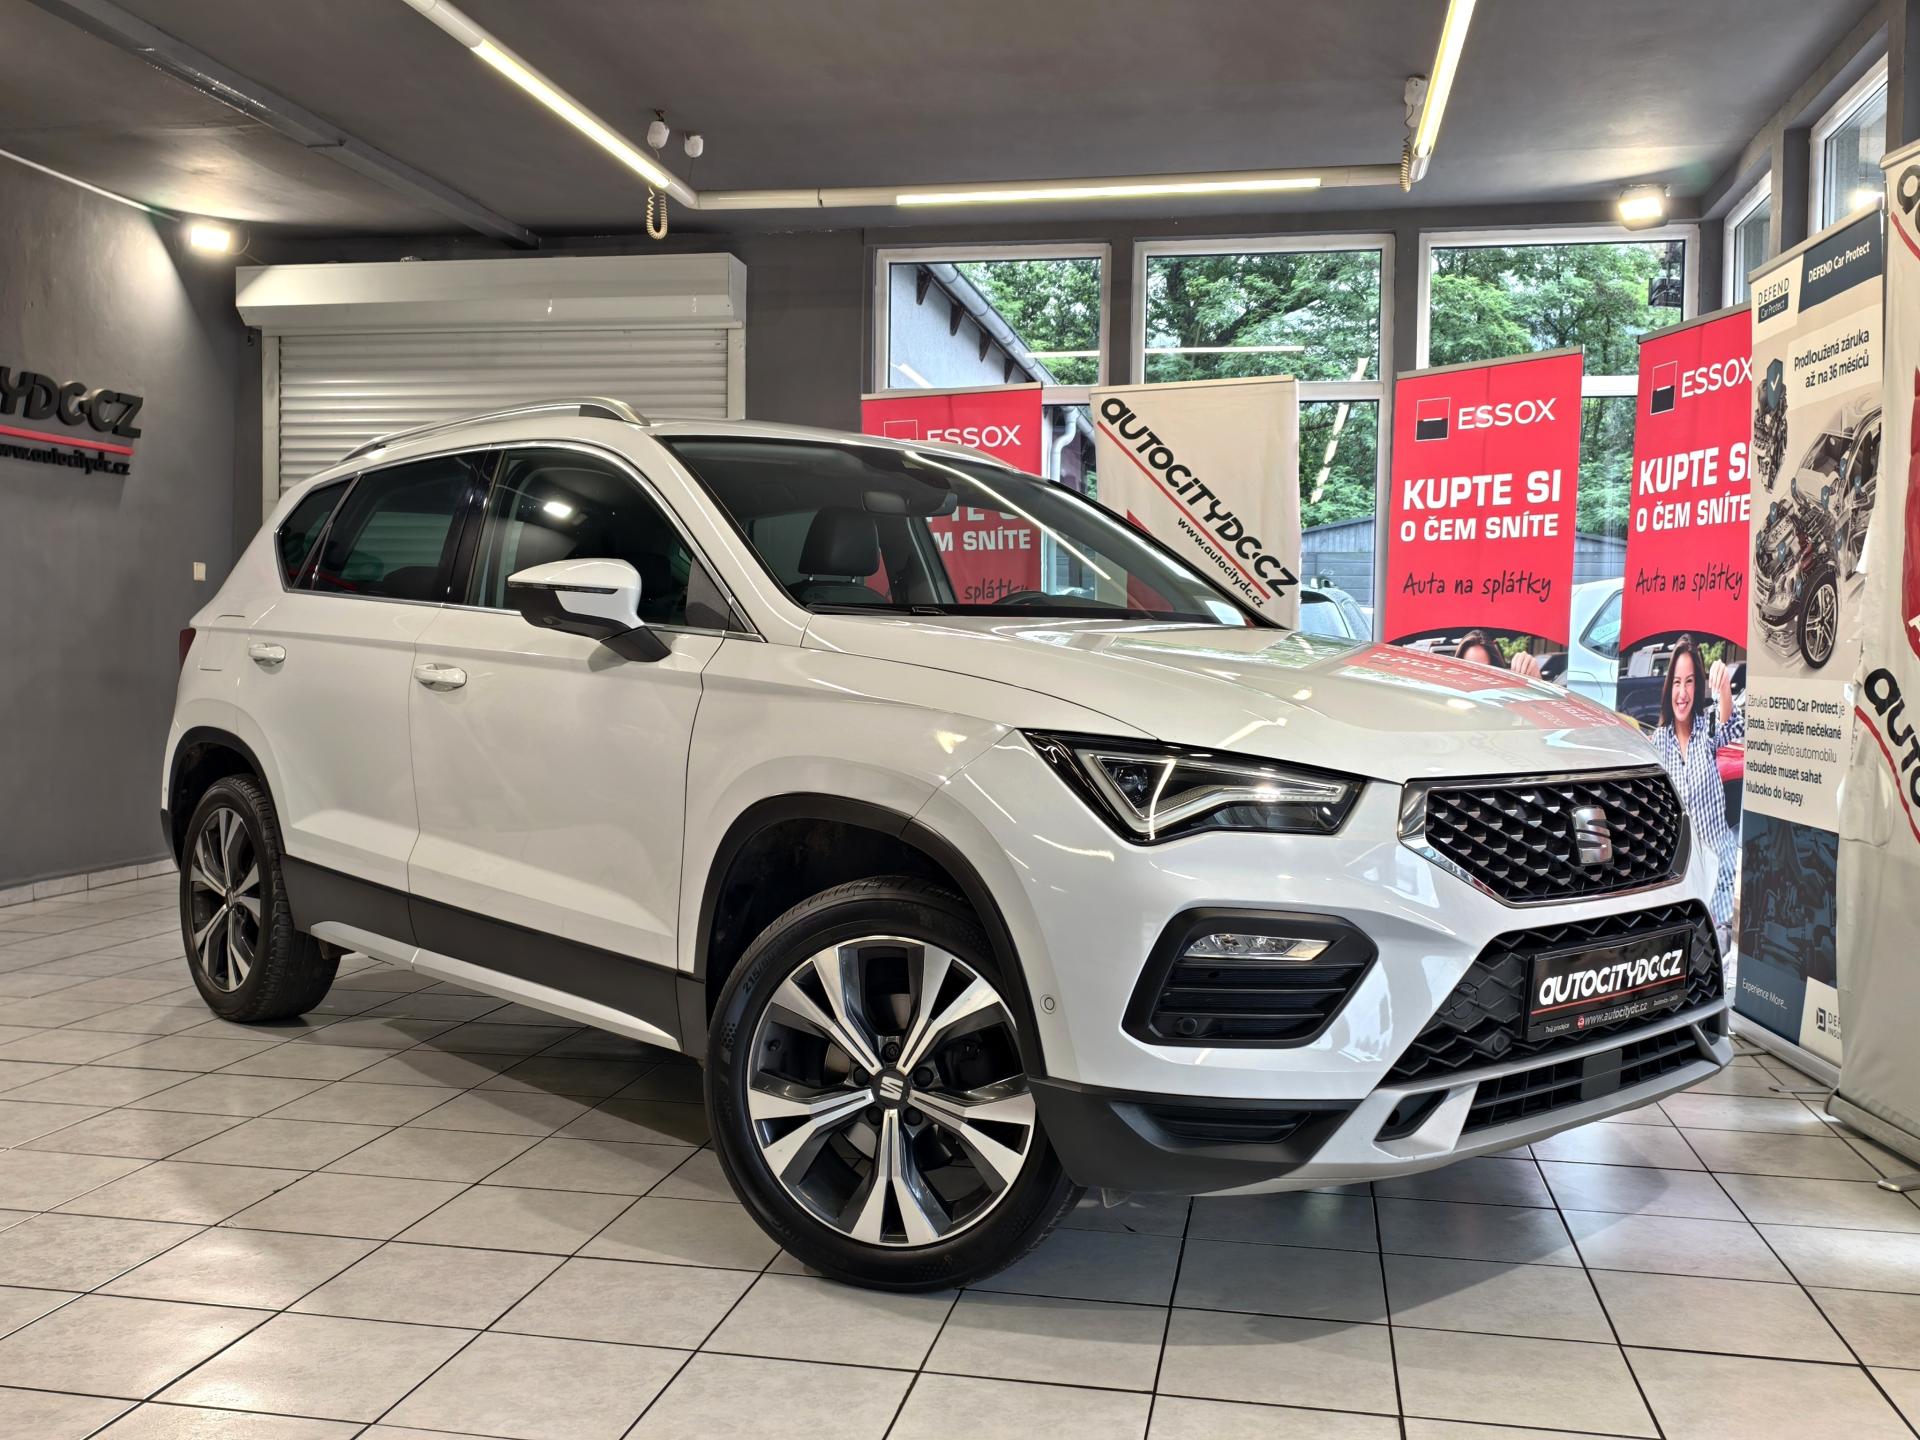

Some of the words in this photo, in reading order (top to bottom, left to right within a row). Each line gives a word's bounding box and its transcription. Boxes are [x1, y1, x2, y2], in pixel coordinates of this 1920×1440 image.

[1808, 260, 1833, 283] DEFEND
[1834, 256, 1845, 269] Car
[1845, 241, 1870, 264] Protect
[1758, 278, 1790, 305] DEFEND
[1760, 307, 1769, 318] Car
[1768, 300, 1785, 315] Protect
[1794, 338, 1839, 371] Prodloužená
[1841, 329, 1869, 352] záruka
[1681, 356, 1752, 398] ESSOX
[1805, 370, 1816, 388] až
[1818, 369, 1828, 385] na
[1829, 363, 1837, 380] 36
[1839, 349, 1869, 376] měsíců
[1457, 397, 1557, 430] ESSOX
[1639, 447, 1719, 496] KUPTE
[1403, 472, 1513, 510] KUPTE
[1527, 469, 1562, 504] SI
[1400, 520, 1416, 541] O
[1423, 514, 1477, 541] ČEM
[1485, 510, 1558, 540] SNÍTE
[1636, 508, 1648, 532] O
[1652, 501, 1691, 531] ČEM
[1696, 490, 1751, 526] SNÍTE
[963, 526, 1031, 551] SNÍTE
[1178, 518, 1264, 608] www.autocitydc.cz
[1403, 571, 1446, 595] Auta
[1454, 579, 1473, 594] na
[1481, 569, 1552, 602] splátky
[1635, 567, 1666, 594] Auta
[1672, 573, 1686, 592] na
[1691, 562, 1743, 601] splátky
[1748, 694, 1768, 708] Záruka
[1769, 697, 1795, 711] DEFEND
[1797, 699, 1809, 712] Car
[1811, 700, 1838, 715] Protect
[1838, 702, 1845, 718] je
[1767, 718, 1774, 731] že
[1775, 720, 1780, 731] v
[1780, 719, 1804, 736] případě
[1806, 723, 1842, 739] nečekané
[1747, 740, 1773, 756] poruchy
[1773, 742, 1795, 757] vašeho
[1796, 746, 1837, 763] automobilu
[1747, 760, 1777, 776] nebudete
[1778, 767, 1799, 780] muset
[1800, 769, 1822, 784] sahat
[1746, 780, 1772, 797] hluboko
[1773, 785, 1782, 799] do
[1743, 977, 1769, 1001] Experience
[1585, 1002, 1648, 1026] www.autocitydc.cz
